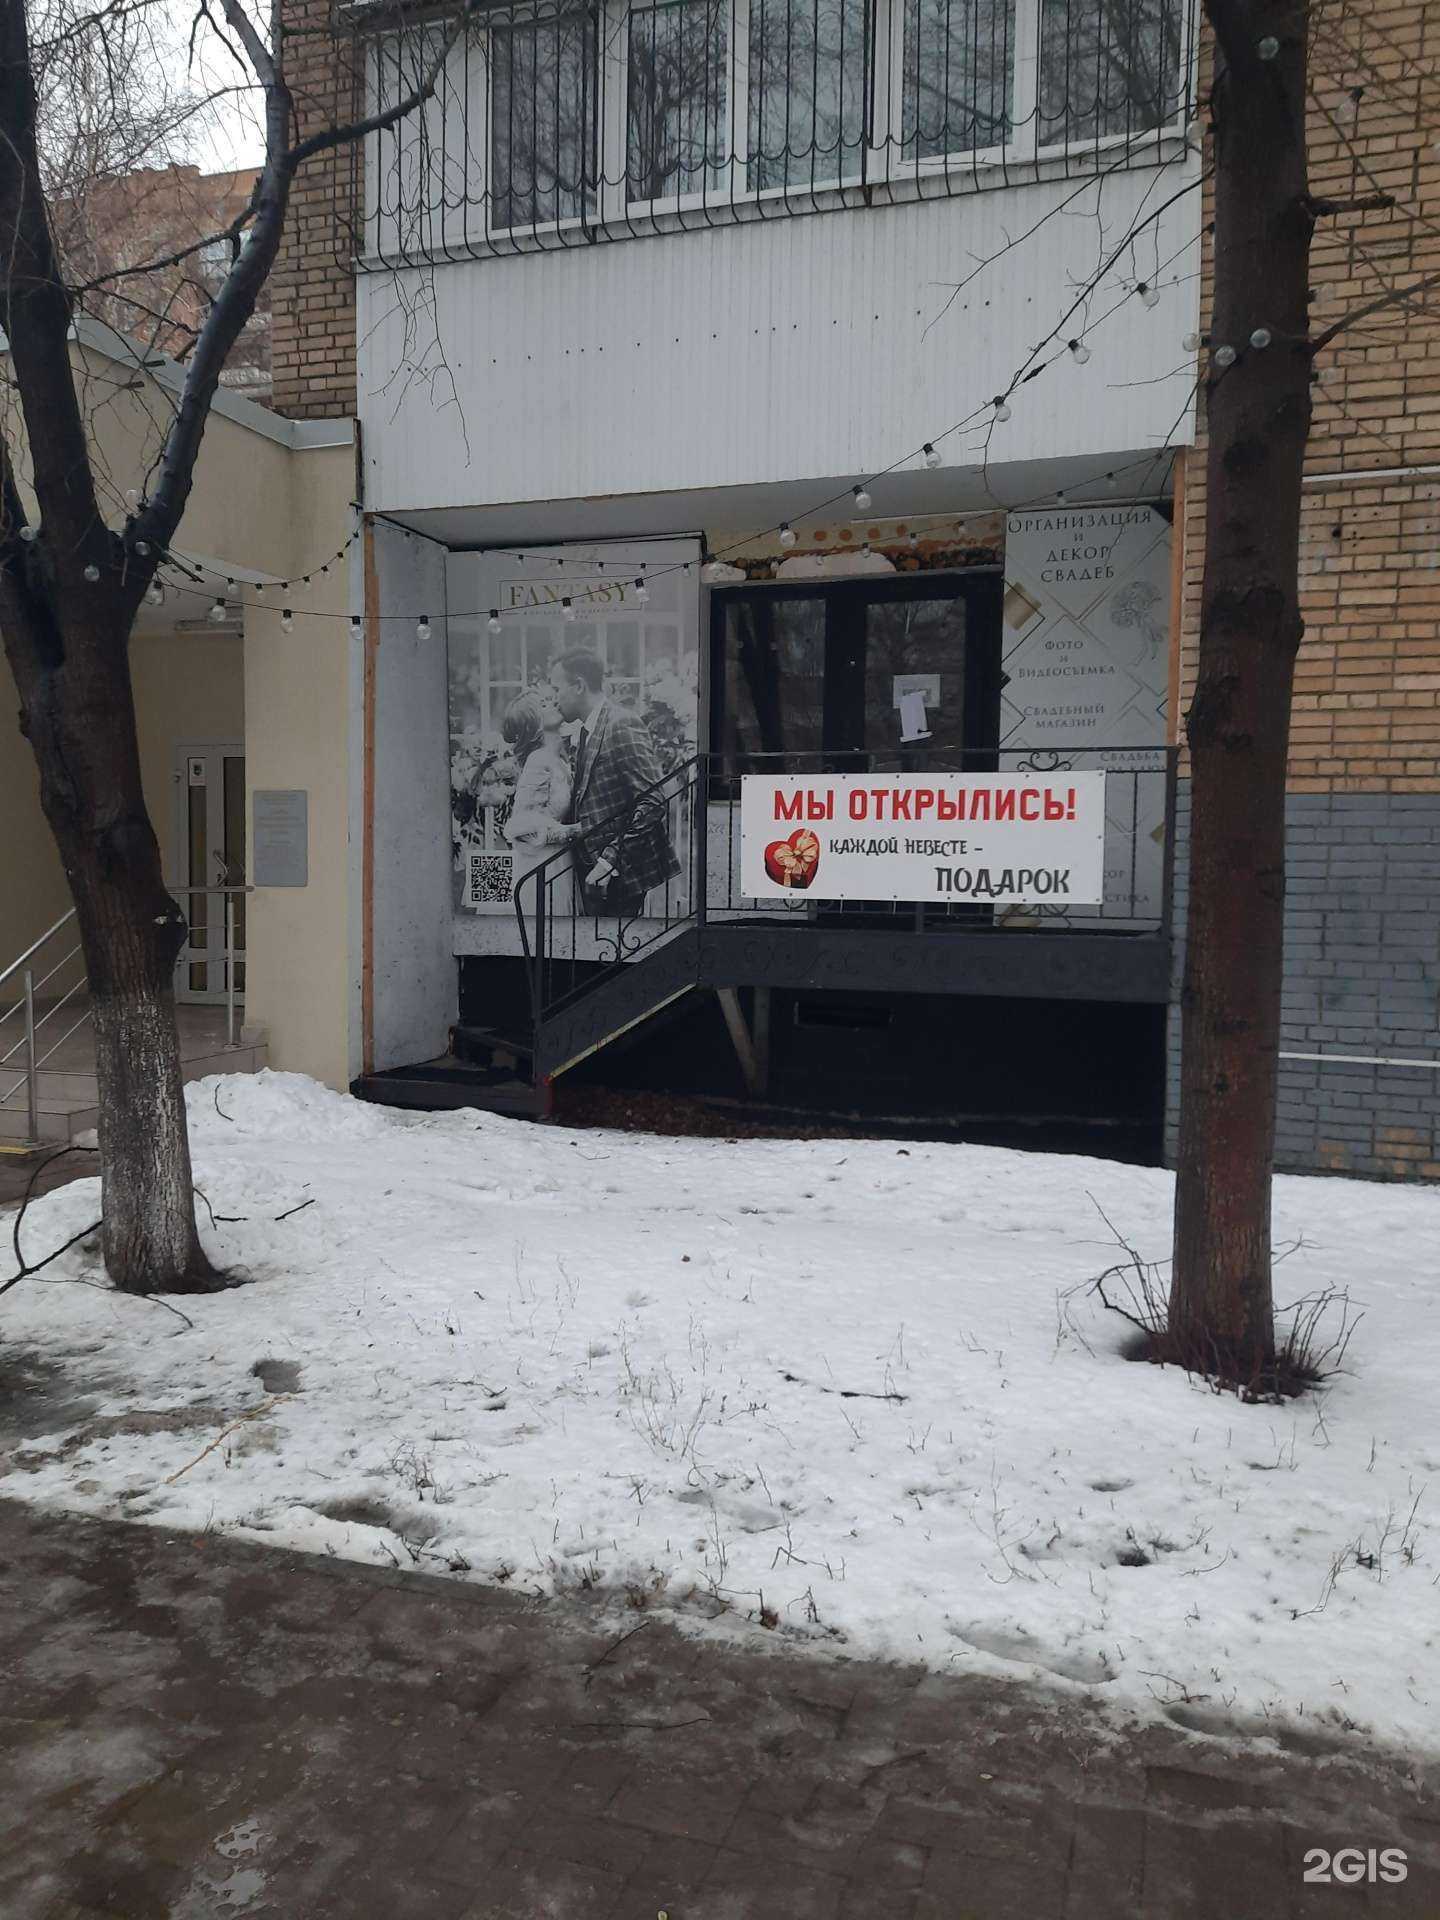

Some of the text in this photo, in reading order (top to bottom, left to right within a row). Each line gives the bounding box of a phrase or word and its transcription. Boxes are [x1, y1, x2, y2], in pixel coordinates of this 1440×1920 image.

[1008, 511, 1151, 533] ОРГАНИЗАЦИЯ
[1046, 546, 1109, 562] ДЕКОР
[1041, 566, 1114, 583] СВАДЕБ
[510, 582, 629, 607] FANTASY
[1044, 640, 1084, 650] ФОТО
[1023, 703, 1104, 716] СВАДЕБНЫЙ
[1036, 718, 1096, 728] МАГАЗИН
[774, 788, 1076, 820] МЫ ОТКРЫЛИСЬ!
[829, 838, 898, 857] КАЖДОЙ
[904, 838, 968, 857] НЕВЕСТЕ
[934, 866, 1070, 897] ПОДАРОК
